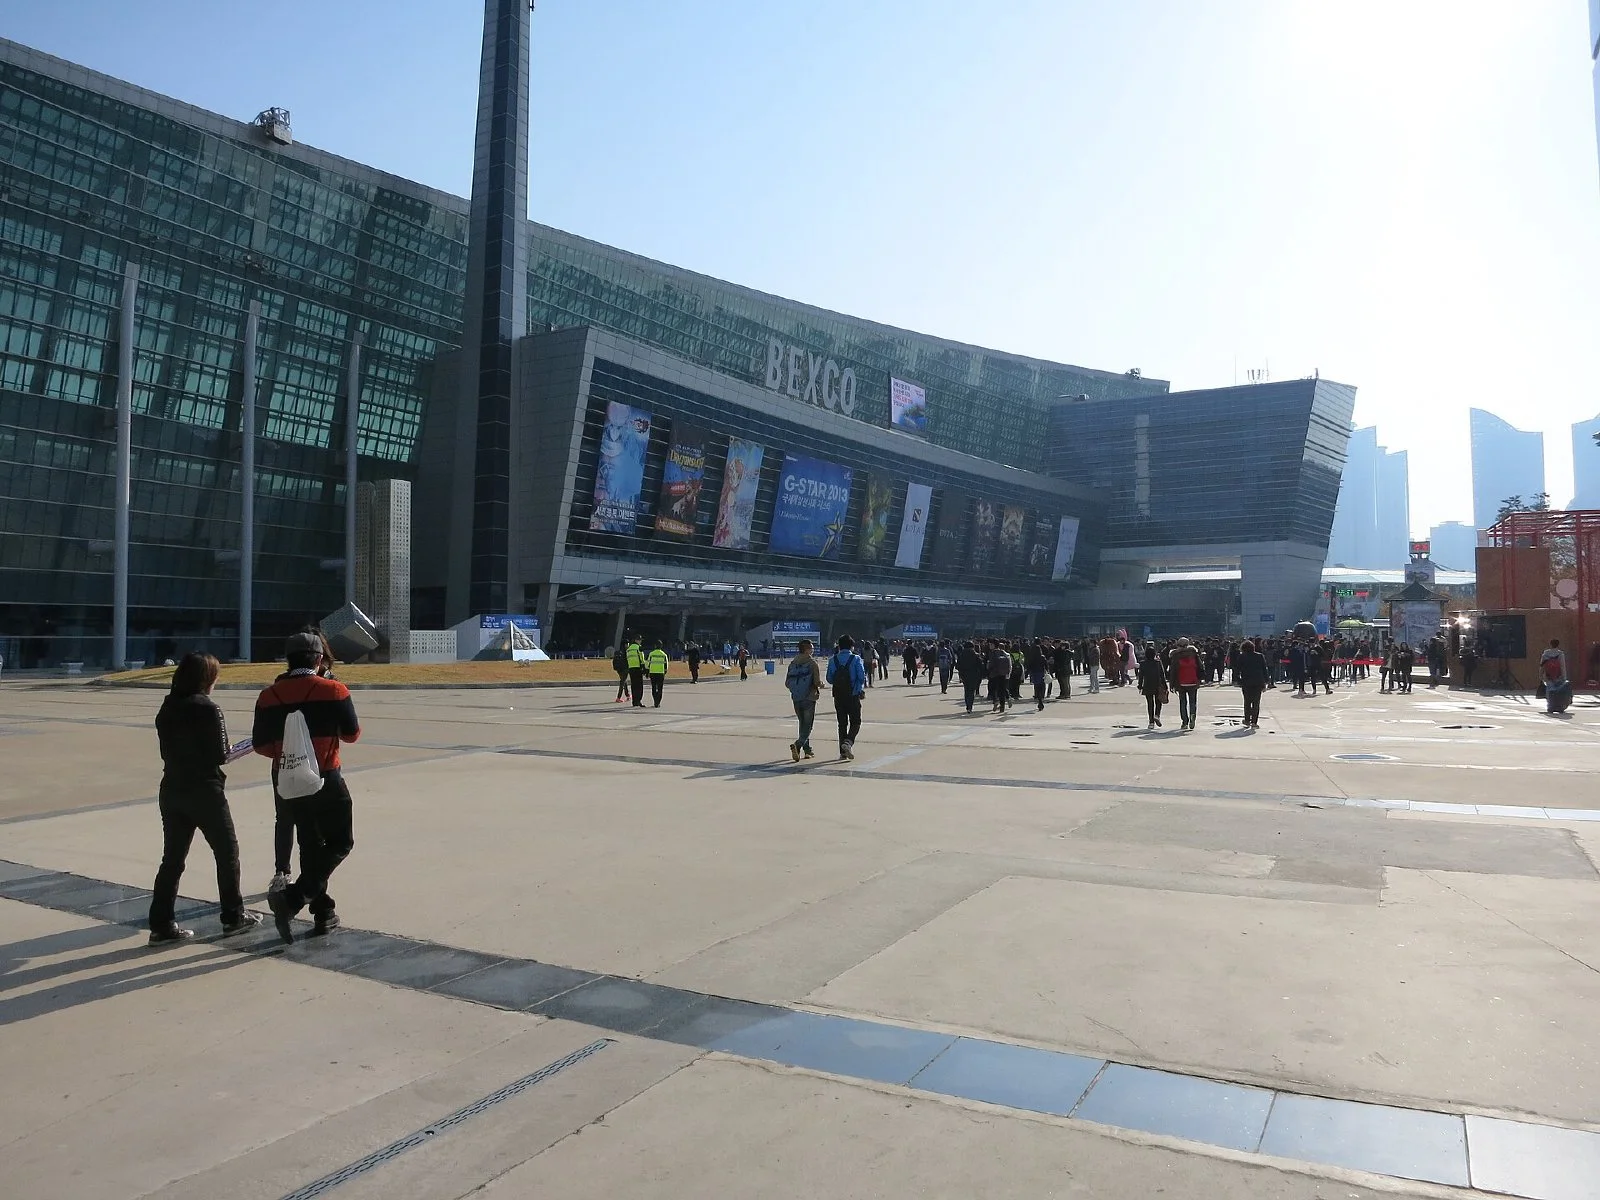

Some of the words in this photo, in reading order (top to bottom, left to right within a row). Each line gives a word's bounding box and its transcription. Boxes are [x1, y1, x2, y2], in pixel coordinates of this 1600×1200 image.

[765, 336, 857, 415] BEXCO
[784, 475, 827, 499] G-STAR
[828, 485, 849, 503] 2013
